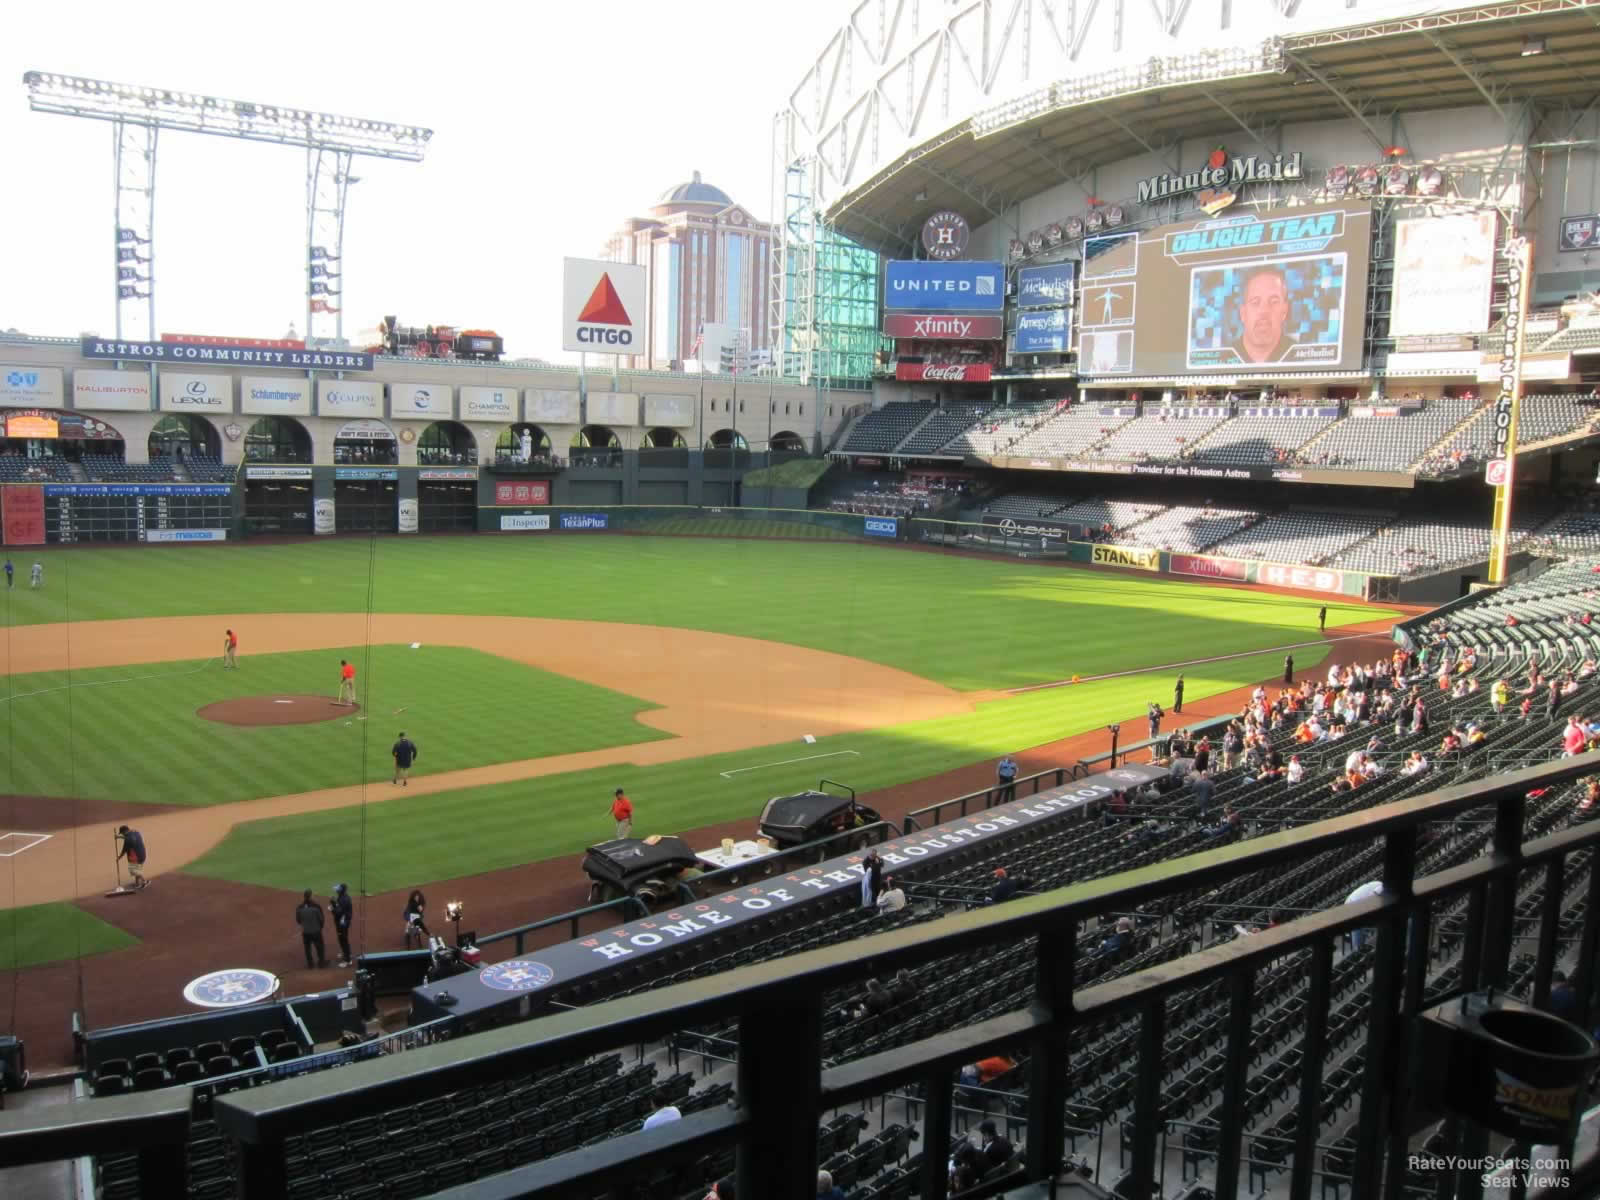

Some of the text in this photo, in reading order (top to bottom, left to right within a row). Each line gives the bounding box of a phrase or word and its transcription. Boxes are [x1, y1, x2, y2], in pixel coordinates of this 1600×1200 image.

[1136, 152, 1302, 203] Minute Maid
[928, 213, 964, 227] HOUSTON
[1172, 223, 1264, 253] OBLIQUE
[929, 246, 961, 257] ASTROS
[893, 279, 971, 291] UNITED
[914, 316, 971, 337] xfinity
[576, 326, 633, 345] CITGO
[94, 343, 364, 367] ASTROS COMMUNITY LEADERS
[76, 385, 148, 395] HALLIBURTON
[250, 389, 302, 402] Schlumberger
[171, 396, 222, 405] LEXUS
[468, 401, 510, 411] CHAMPION
[1066, 461, 1250, 478] Official Health Care Provider for the Houston Astros
[512, 517, 548, 528] Insperity
[562, 517, 605, 528] TexanPlus
[865, 520, 896, 533] GEICO
[1094, 547, 1157, 568] STANLEY
[1188, 558, 1227, 577] xfinity
[1266, 566, 1334, 589] H-E-B
[592, 784, 1113, 960] HOME OF THE HOUSTON ASTROS
[579, 886, 763, 947] WELCOME
